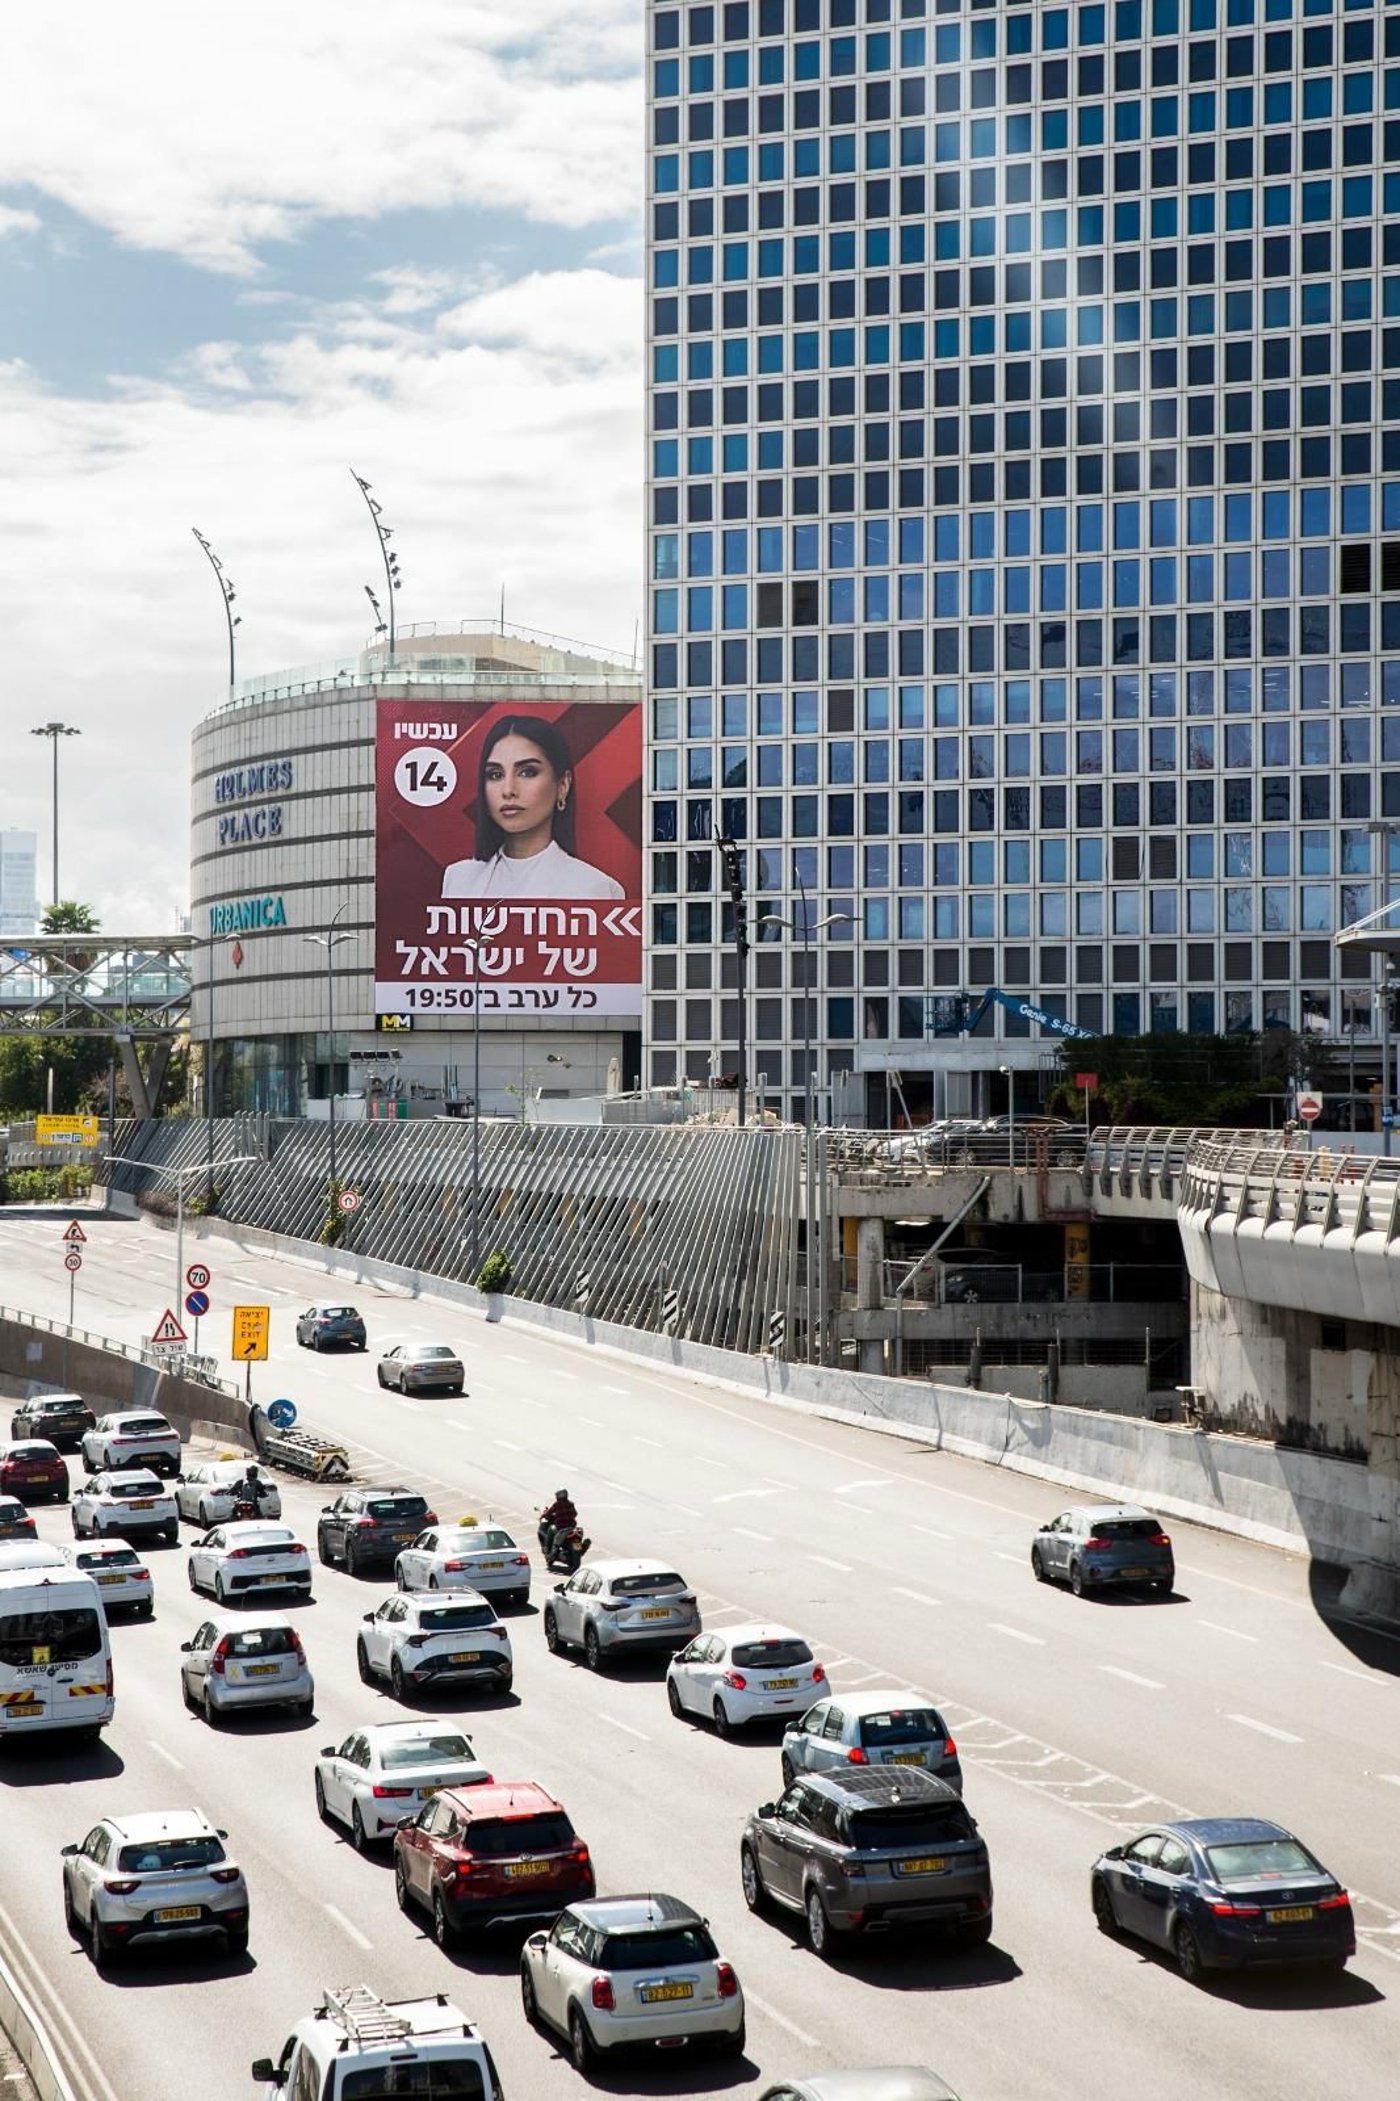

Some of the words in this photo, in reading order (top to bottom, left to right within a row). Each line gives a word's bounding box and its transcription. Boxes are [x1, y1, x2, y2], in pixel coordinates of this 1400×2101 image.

[394, 722, 458, 740] עכשיו
[214, 761, 293, 803] HOLMES
[405, 761, 448, 792] 14
[218, 806, 282, 845] PLACE
[209, 897, 287, 935] URBANICA
[426, 905, 598, 936] החדשות
[396, 940, 524, 977] ישראל
[537, 941, 598, 976] של
[508, 989, 560, 1009] ערב
[567, 986, 597, 1009] כל
[1019, 1004, 1047, 1024] Genie
[192, 1271, 206, 1284] 70
[241, 1331, 260, 1339] EXIT
